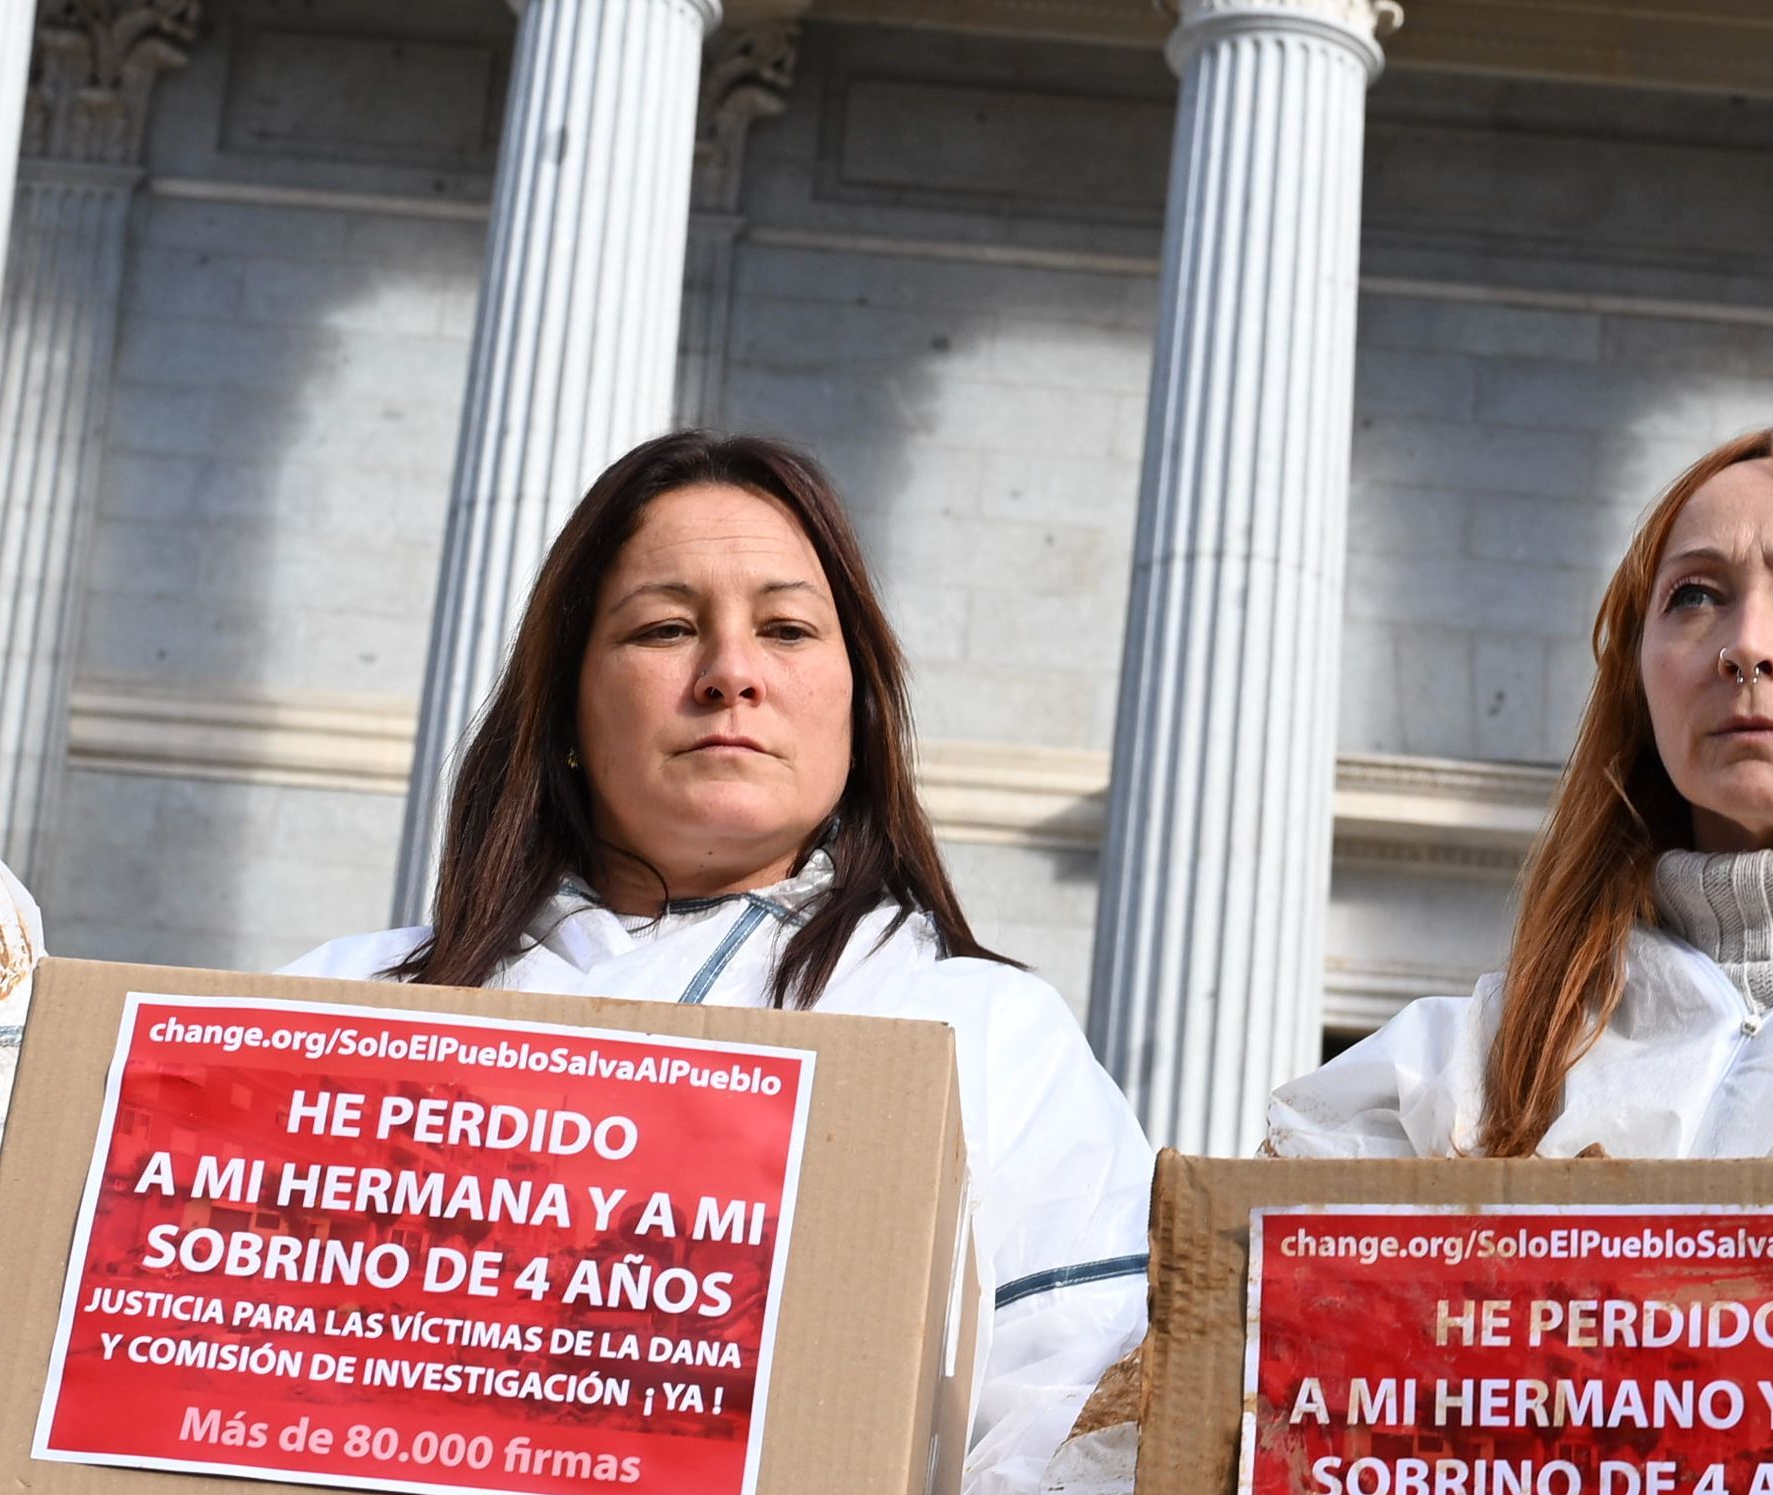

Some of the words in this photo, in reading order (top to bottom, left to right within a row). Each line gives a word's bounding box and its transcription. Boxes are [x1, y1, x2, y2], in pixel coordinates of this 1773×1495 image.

[149, 1016, 782, 1096] change.org/SoloElPuebloSalvaAlPueblo
[287, 1090, 366, 1138] HE
[376, 1096, 638, 1160] PERDIDO
[134, 1151, 175, 1196] A
[190, 1155, 265, 1204] MI
[277, 1162, 571, 1228] HERMANA
[588, 1186, 627, 1231] Y
[634, 1191, 676, 1238] A
[692, 1196, 766, 1245] MI
[142, 1224, 410, 1289] SOBRINO
[423, 1247, 503, 1297] DE
[514, 1257, 550, 1301] 4
[561, 1253, 733, 1317] AÑOS
[84, 1287, 224, 1325] JUSTICIA
[232, 1301, 316, 1334] PARA
[324, 1309, 384, 1339] LAS
[390, 1311, 544, 1353] VÍCTIMAS
[549, 1328, 594, 1356] DE
[599, 1332, 640, 1361] LA
[648, 1336, 742, 1369] DANA
[1436, 1299, 1512, 1347] HE
[100, 1332, 124, 1360] Y
[128, 1335, 303, 1378] COMISIÓN
[308, 1353, 357, 1384] DE
[362, 1358, 630, 1406] INVESTIGACIÓN
[1289, 1377, 1330, 1424] A
[1347, 1378, 1417, 1426] MI
[1434, 1378, 1745, 1430] HERMANO
[179, 1406, 269, 1448] Más
[278, 1416, 334, 1455] de
[343, 1424, 494, 1470] 80.000
[504, 1436, 641, 1483] firmas
